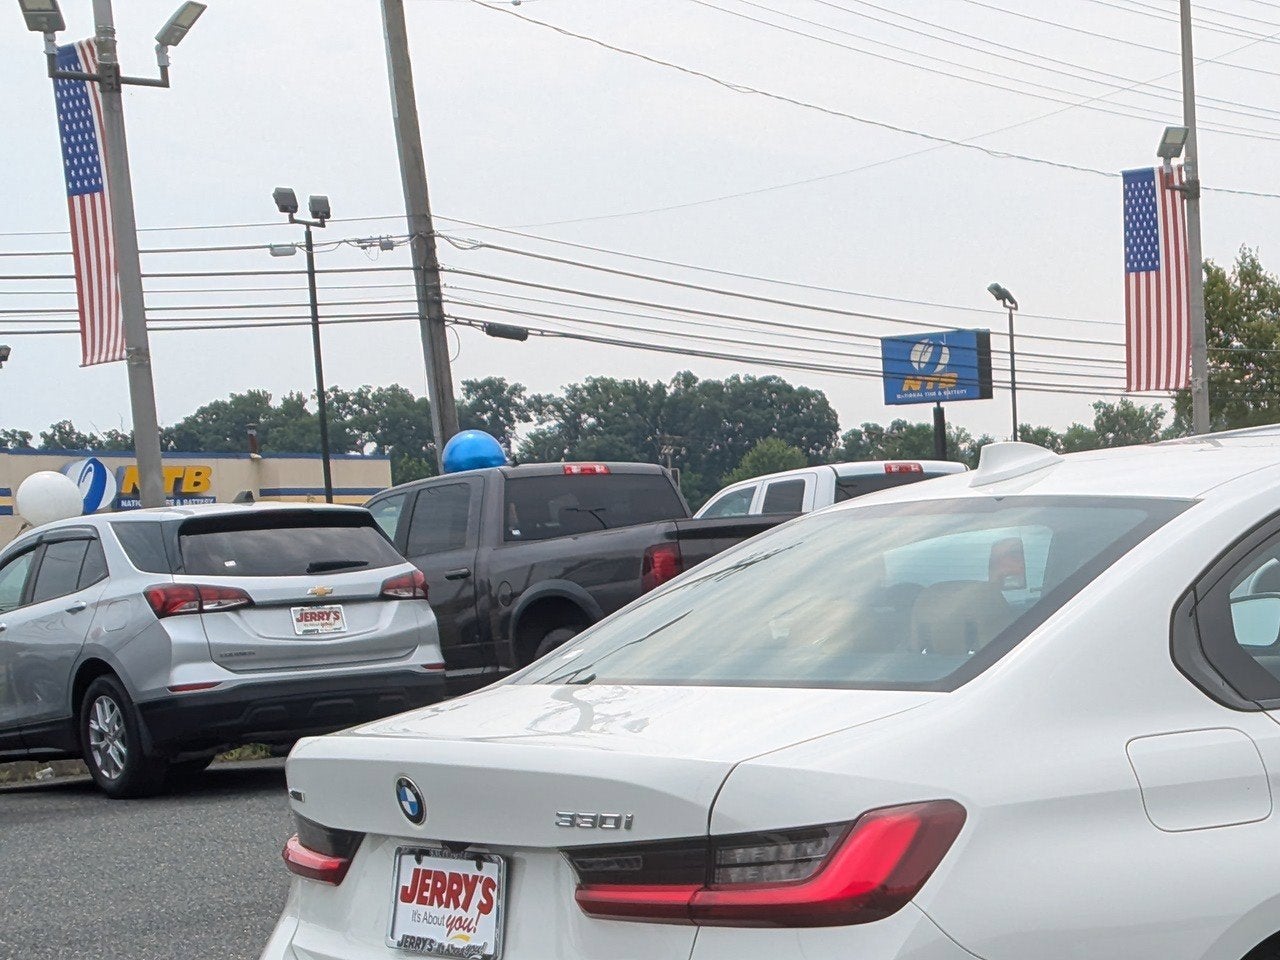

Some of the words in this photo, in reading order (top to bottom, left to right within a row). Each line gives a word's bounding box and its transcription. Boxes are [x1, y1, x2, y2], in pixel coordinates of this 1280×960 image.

[296, 610, 341, 623] JERRY'S
[555, 811, 634, 830] 330i
[400, 867, 497, 915] JERRY'S
[411, 909, 421, 923] It's
[422, 910, 445, 926] About
[397, 933, 435, 951] JERRY'S
